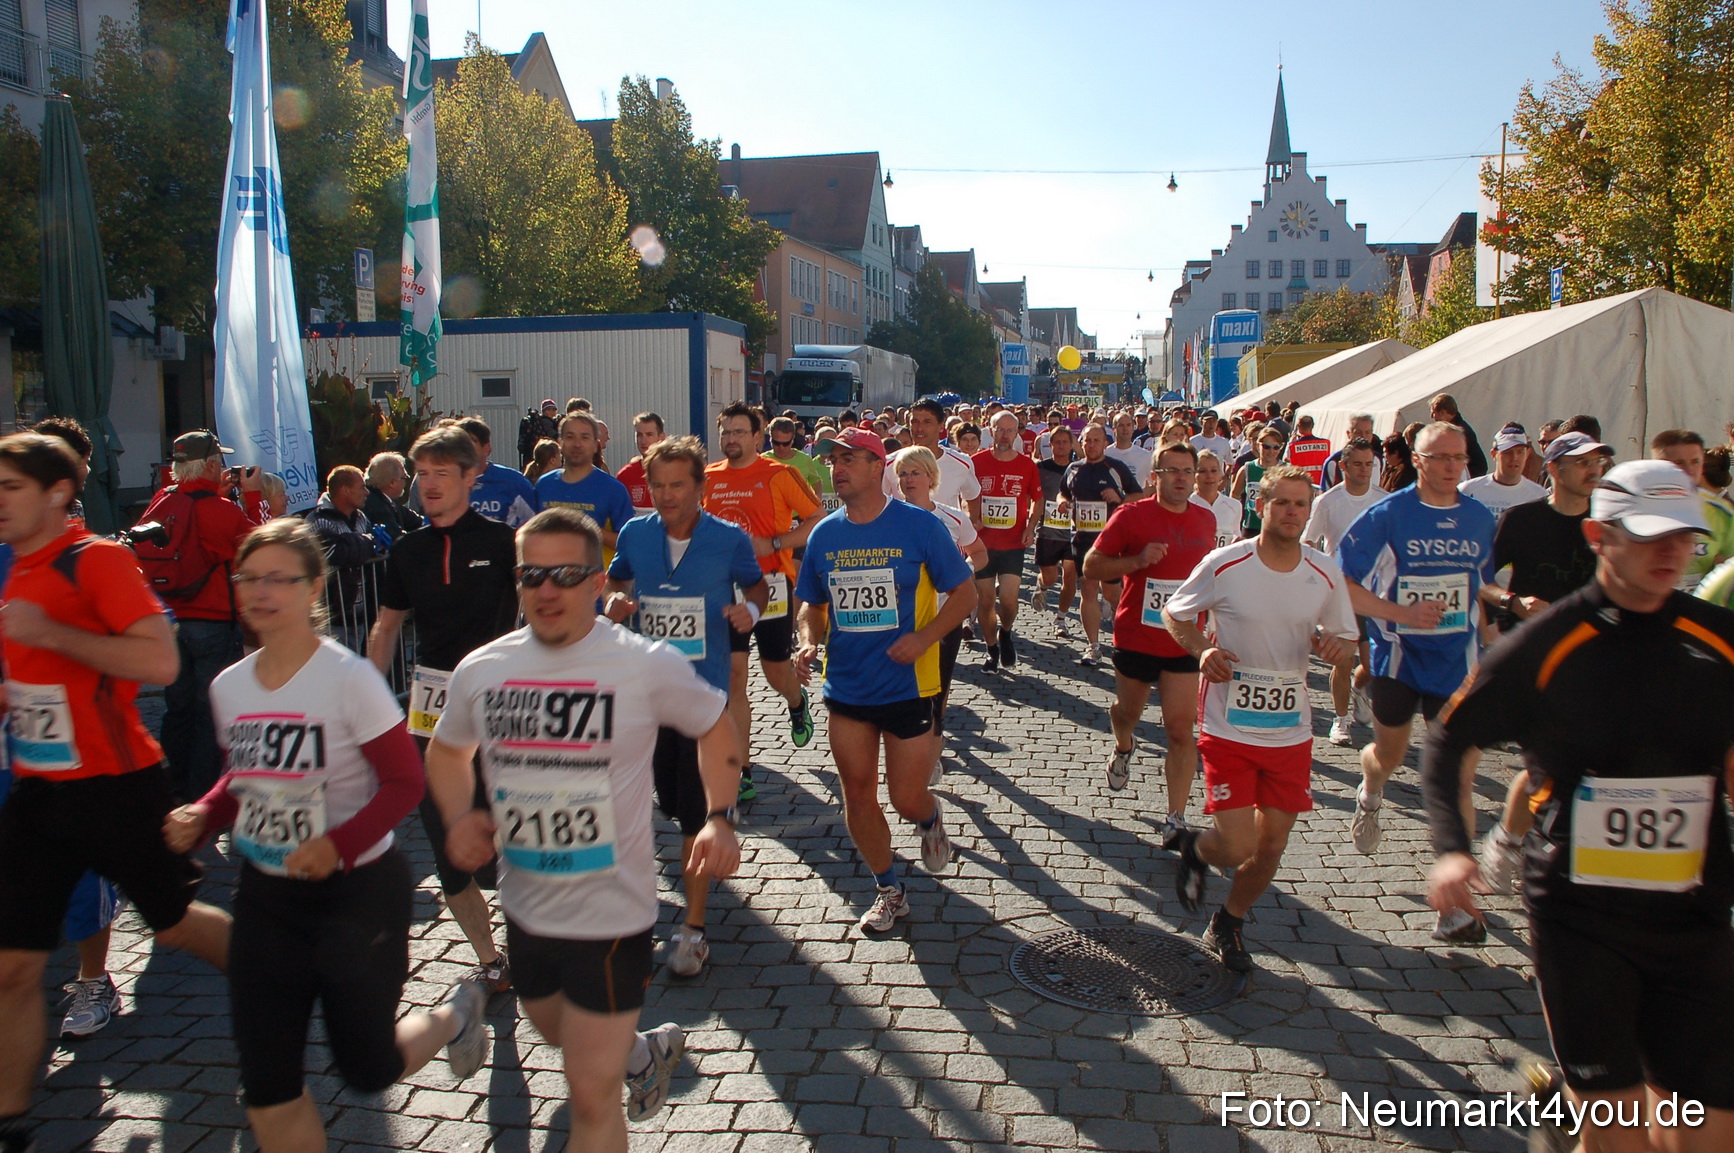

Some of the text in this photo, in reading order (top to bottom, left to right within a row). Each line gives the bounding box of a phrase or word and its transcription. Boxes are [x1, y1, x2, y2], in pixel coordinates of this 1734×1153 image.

[1221, 318, 1256, 337] maxi
[987, 505, 1010, 518] 572
[1080, 509, 1101, 521] 515
[837, 548, 903, 558] NEUMARKTER
[1406, 539, 1480, 557] SYSCAD
[834, 557, 889, 568] STADTLAUF
[837, 586, 888, 610] 2738
[644, 614, 697, 638] 3523
[846, 612, 882, 624] Lothar
[1236, 684, 1297, 711] 3536
[544, 689, 616, 741] 97.1
[263, 722, 327, 770] 97.1
[504, 805, 600, 847] 2183
[1604, 807, 1688, 849] 982
